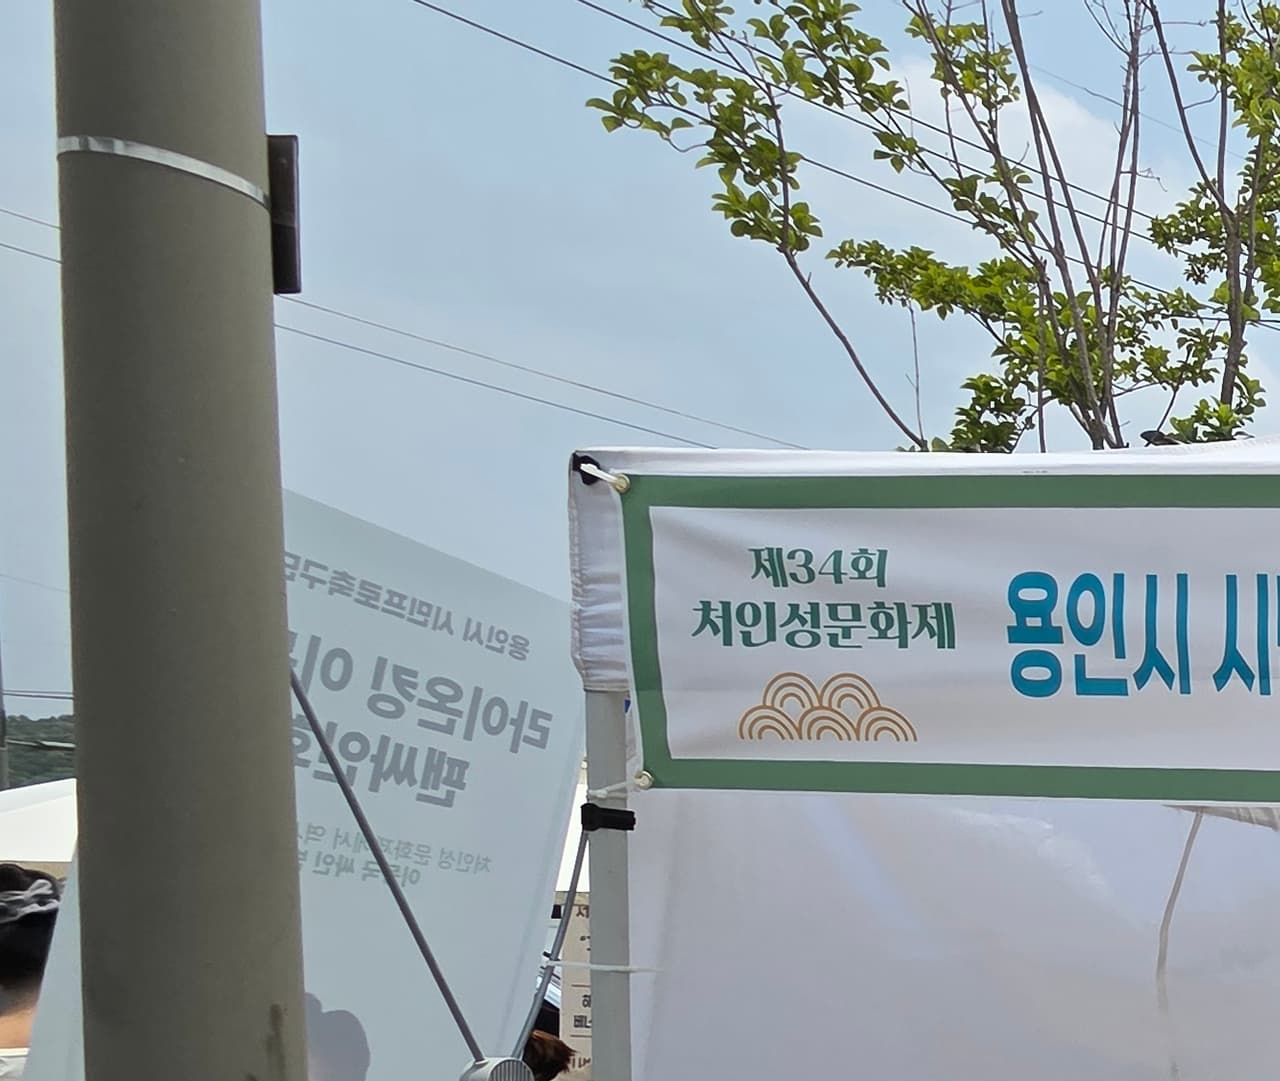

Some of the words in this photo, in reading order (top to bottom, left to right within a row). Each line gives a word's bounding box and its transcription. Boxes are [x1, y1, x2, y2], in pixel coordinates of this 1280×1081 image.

[748, 546, 888, 588] 제34회
[691, 600, 957, 650] 처인성문화제
[1006, 571, 1191, 699] 용인시
